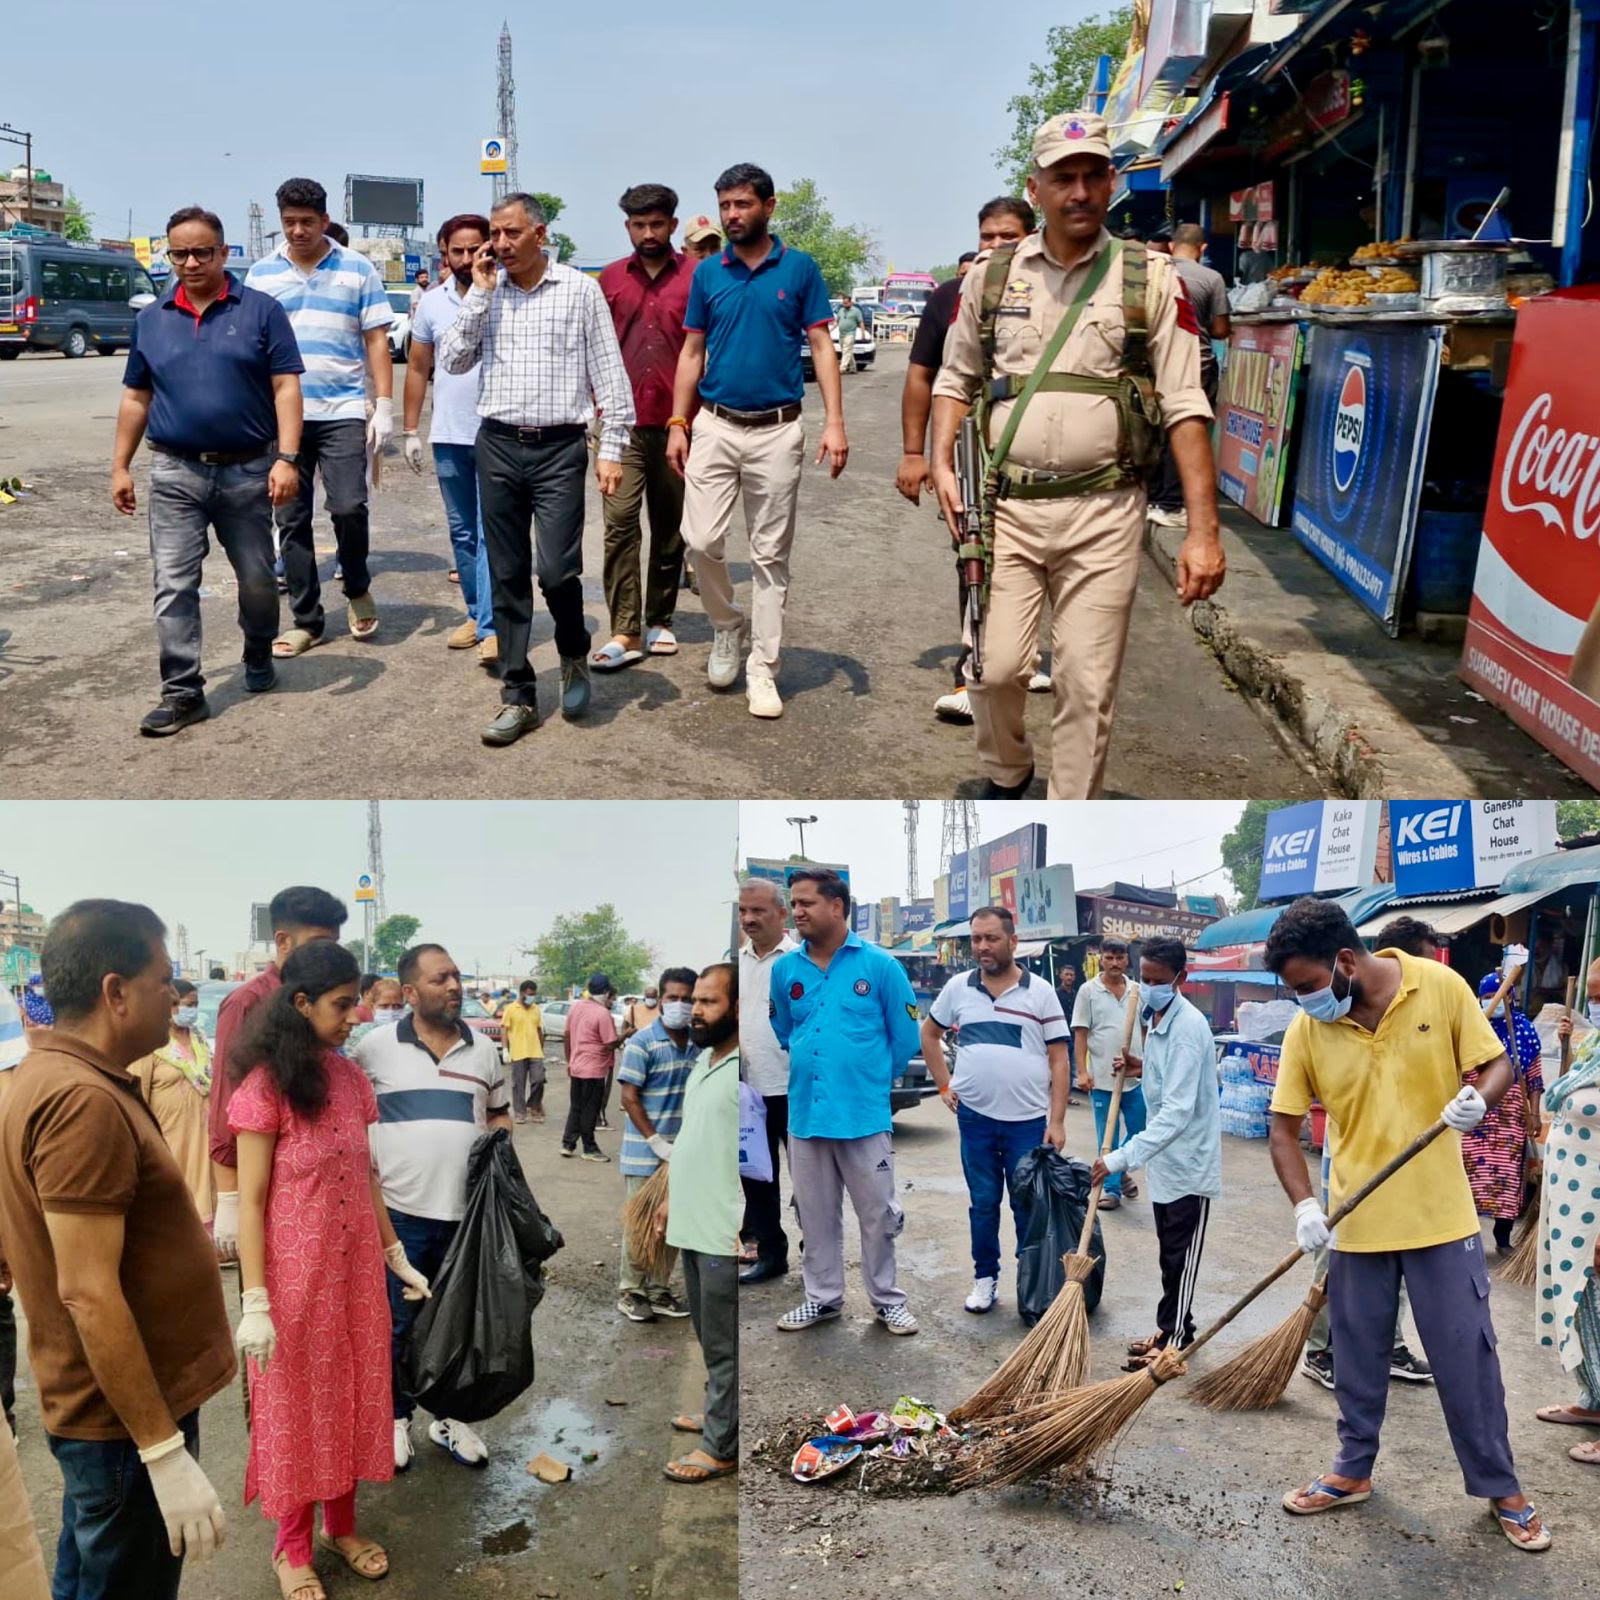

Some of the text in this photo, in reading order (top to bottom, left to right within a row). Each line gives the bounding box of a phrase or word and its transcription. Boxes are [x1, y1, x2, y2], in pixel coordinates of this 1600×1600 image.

[1337, 412, 1362, 445] PEPSI
[1467, 646, 1512, 694] SUKHDEV
[1510, 677, 1540, 715] CHAT
[1539, 696, 1581, 747] HOUSE
[1333, 809, 1353, 823] Kaka
[1483, 800, 1523, 814] Ganesha
[1332, 826, 1350, 839] Chat
[1397, 805, 1462, 846] KEI
[1493, 816, 1515, 830] Chat
[1266, 828, 1316, 859] KEI
[1327, 843, 1351, 856] House
[1490, 835, 1519, 849] House
[1397, 844, 1458, 866] Wires & Cables
[1265, 862, 1281, 874] Wires
[1287, 858, 1308, 871] Cables
[950, 870, 967, 893] KEI
[1102, 916, 1164, 938] SHARMA
